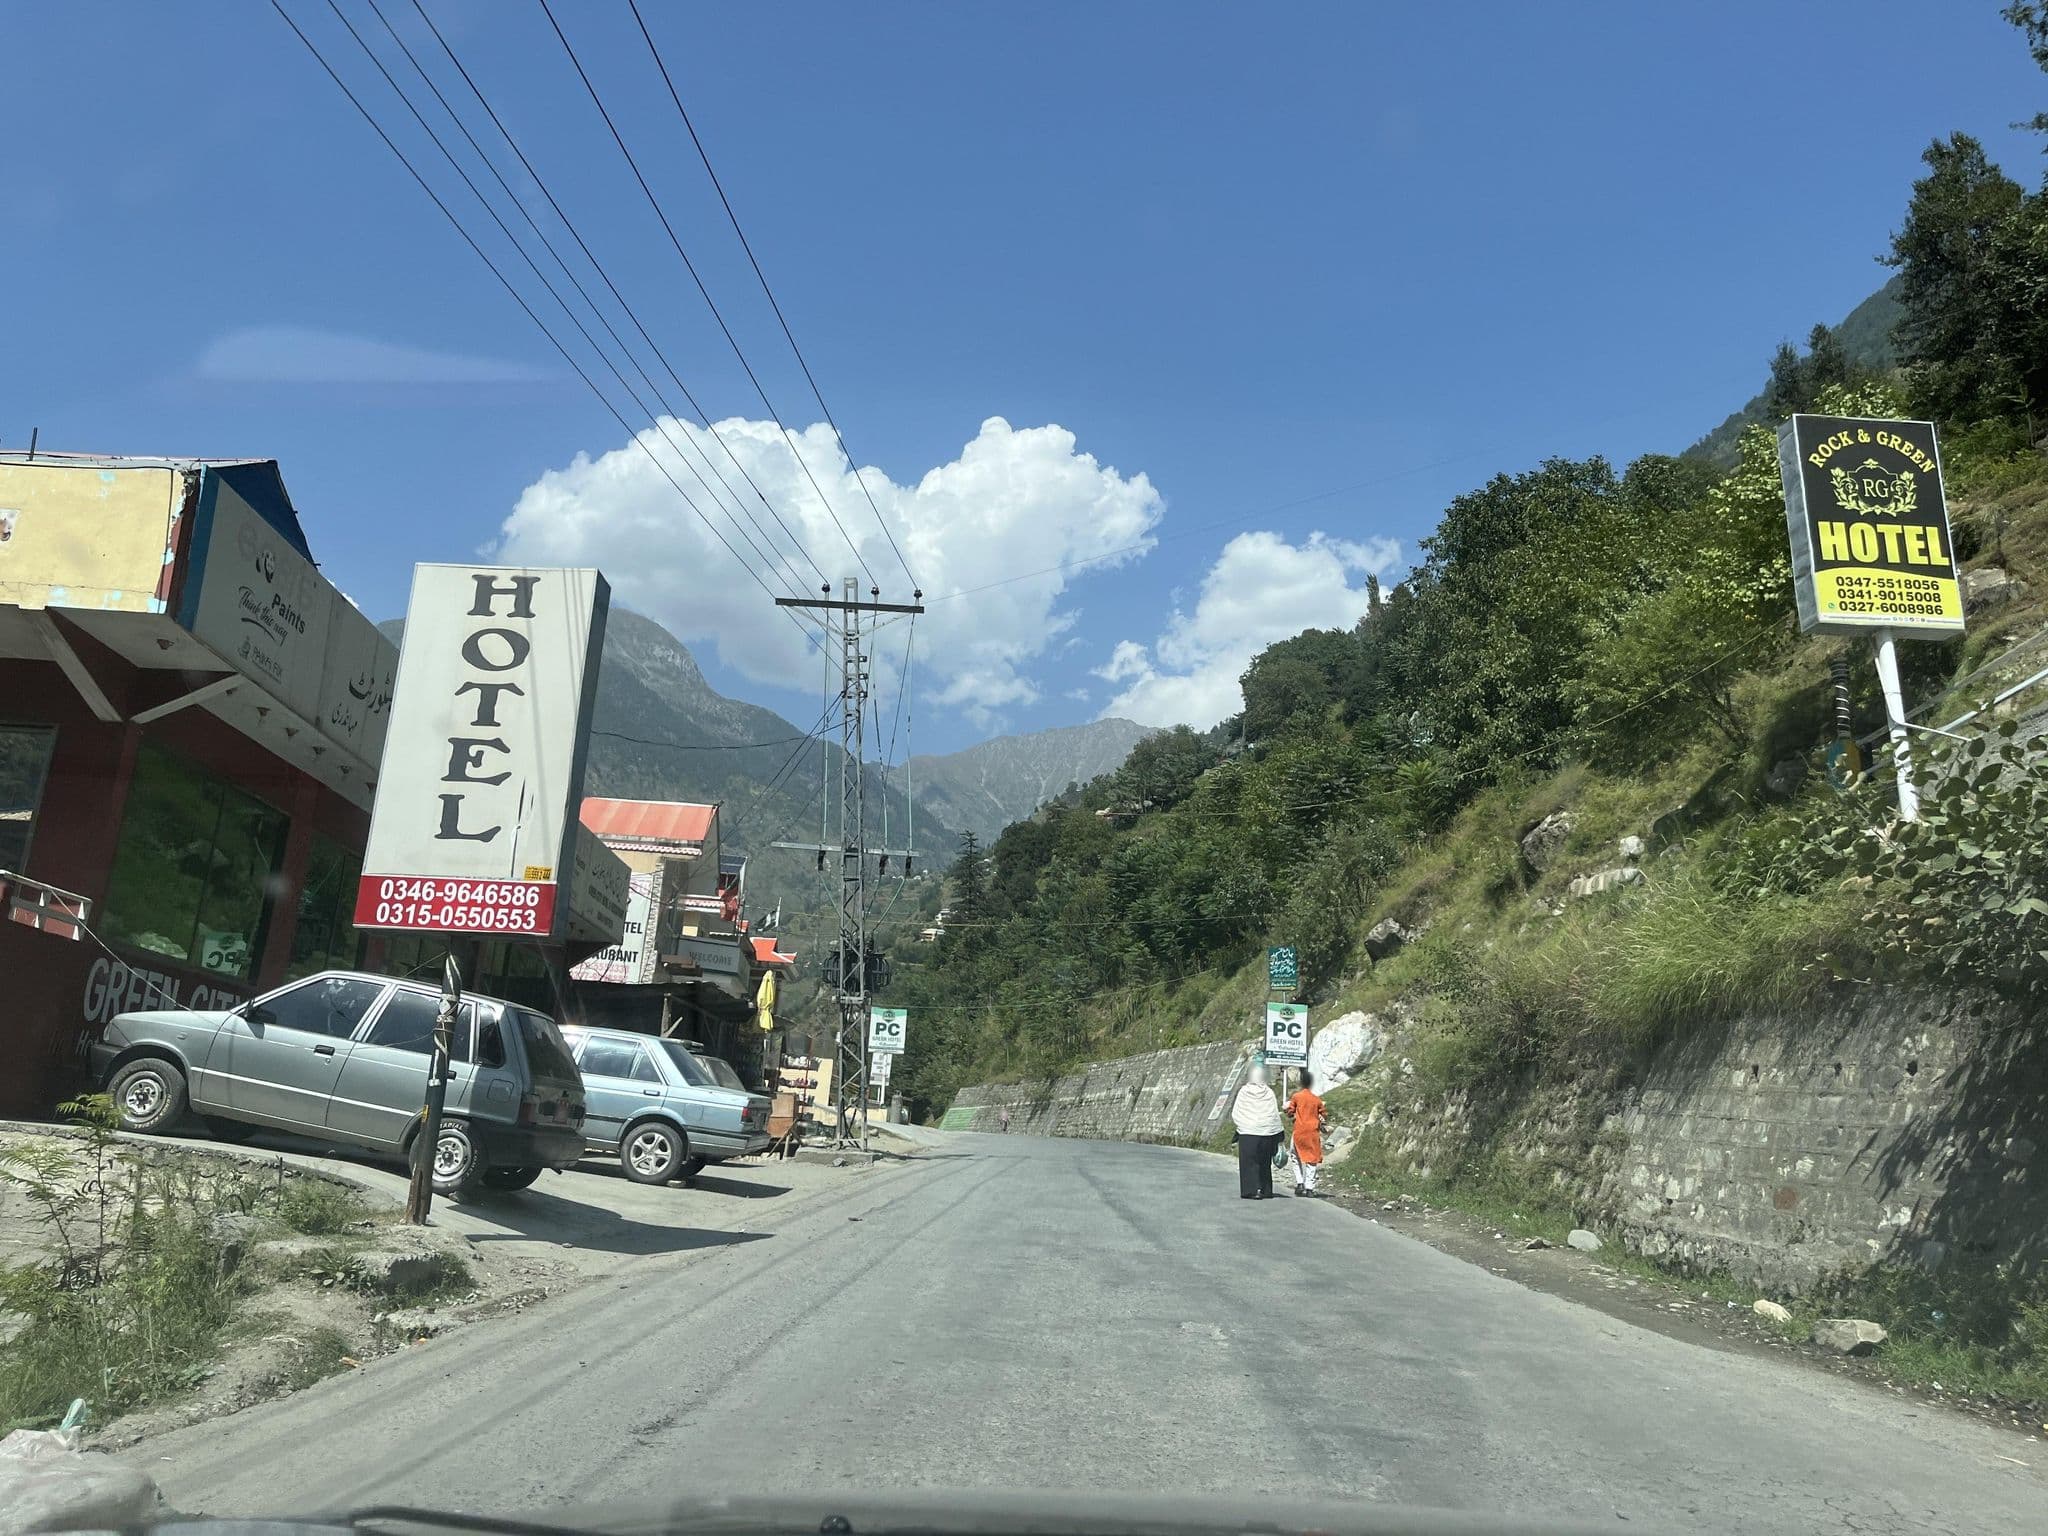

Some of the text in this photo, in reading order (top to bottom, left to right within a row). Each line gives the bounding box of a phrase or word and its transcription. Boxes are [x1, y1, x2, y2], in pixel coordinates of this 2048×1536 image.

[1808, 428, 1936, 474] ROCK & GREEN
[1862, 478, 1889, 498] RG
[1817, 521, 1950, 566] HOTEL
[1836, 576, 1939, 591] 0347-5518056
[1837, 588, 1941, 603] 0341-9015008
[272, 593, 306, 635] Paints
[1839, 601, 1943, 615] 0327-6008986
[434, 574, 541, 843] HOTEL
[380, 879, 540, 907] 0346-9646586
[376, 902, 537, 930] 0315-0550553
[624, 921, 643, 935] TEL
[689, 951, 732, 966] WELCOME
[84, 957, 242, 1024] GREEN CIT
[875, 1022, 900, 1036] PC
[1273, 1021, 1302, 1038] PC
